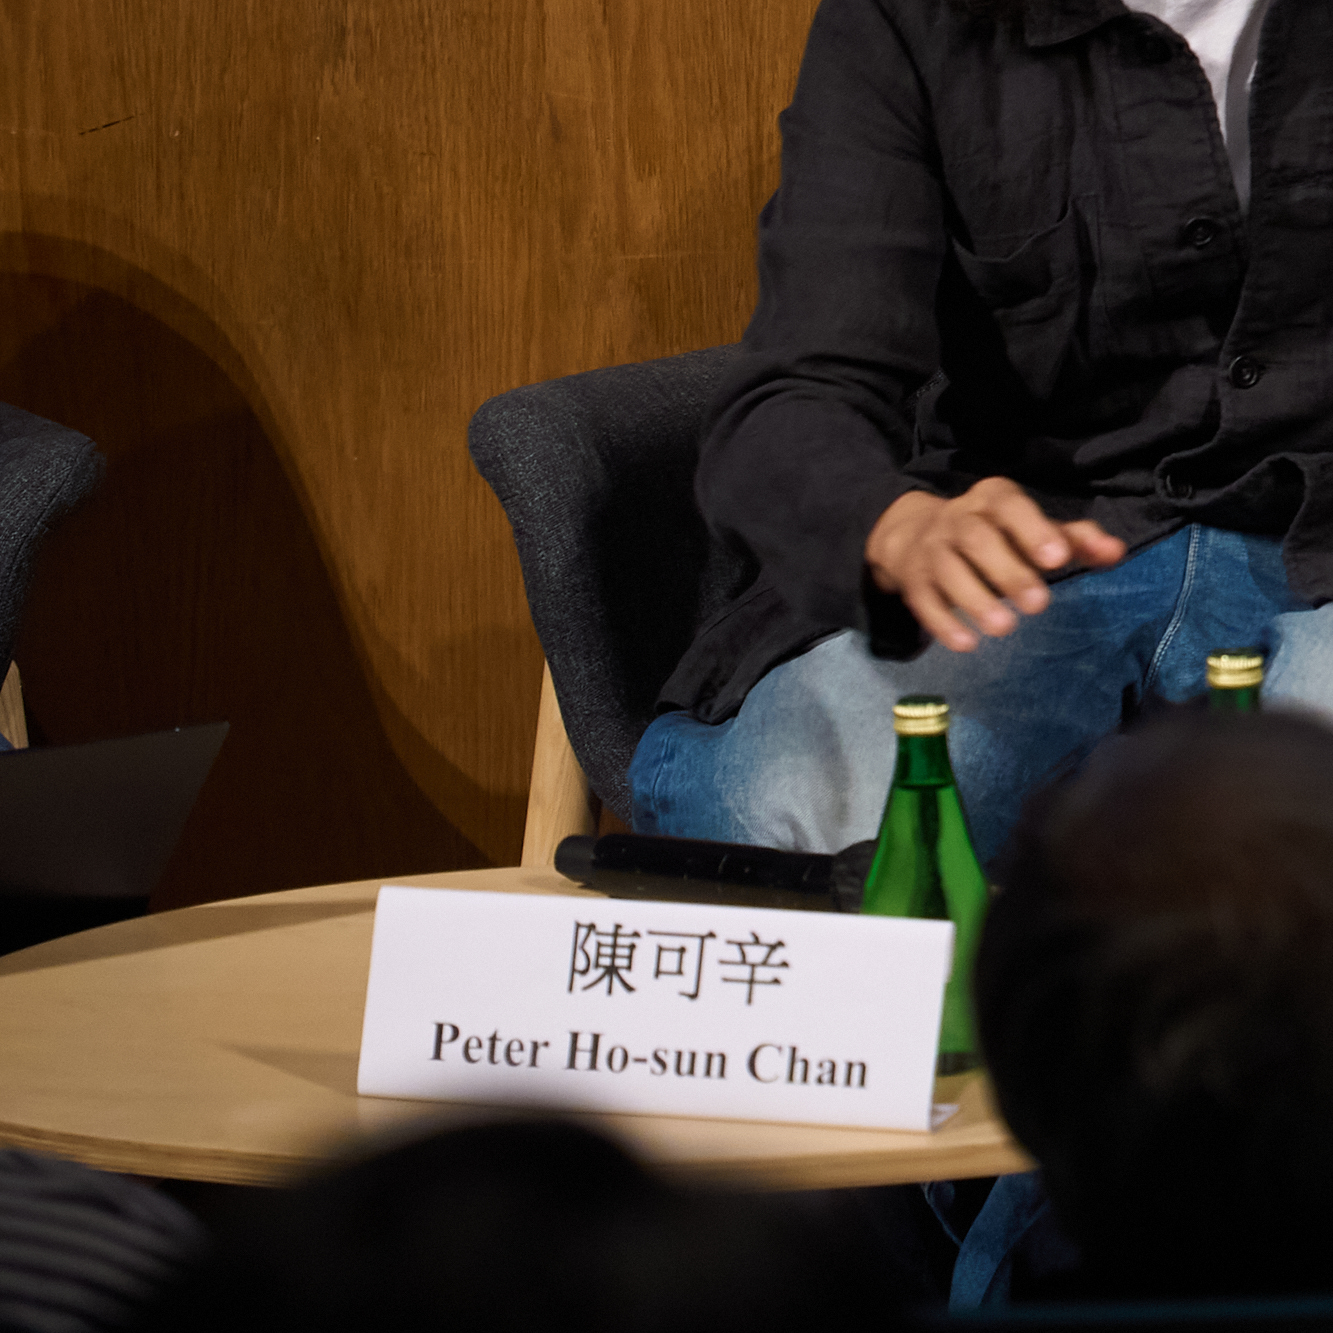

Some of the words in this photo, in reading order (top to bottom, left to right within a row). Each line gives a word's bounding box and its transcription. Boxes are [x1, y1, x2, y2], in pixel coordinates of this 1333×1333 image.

[568, 921, 790, 1005] 陳可辛
[430, 1022, 550, 1068] Peter
[566, 1031, 727, 1079] Ho-sun
[747, 1043, 868, 1088] Chan
